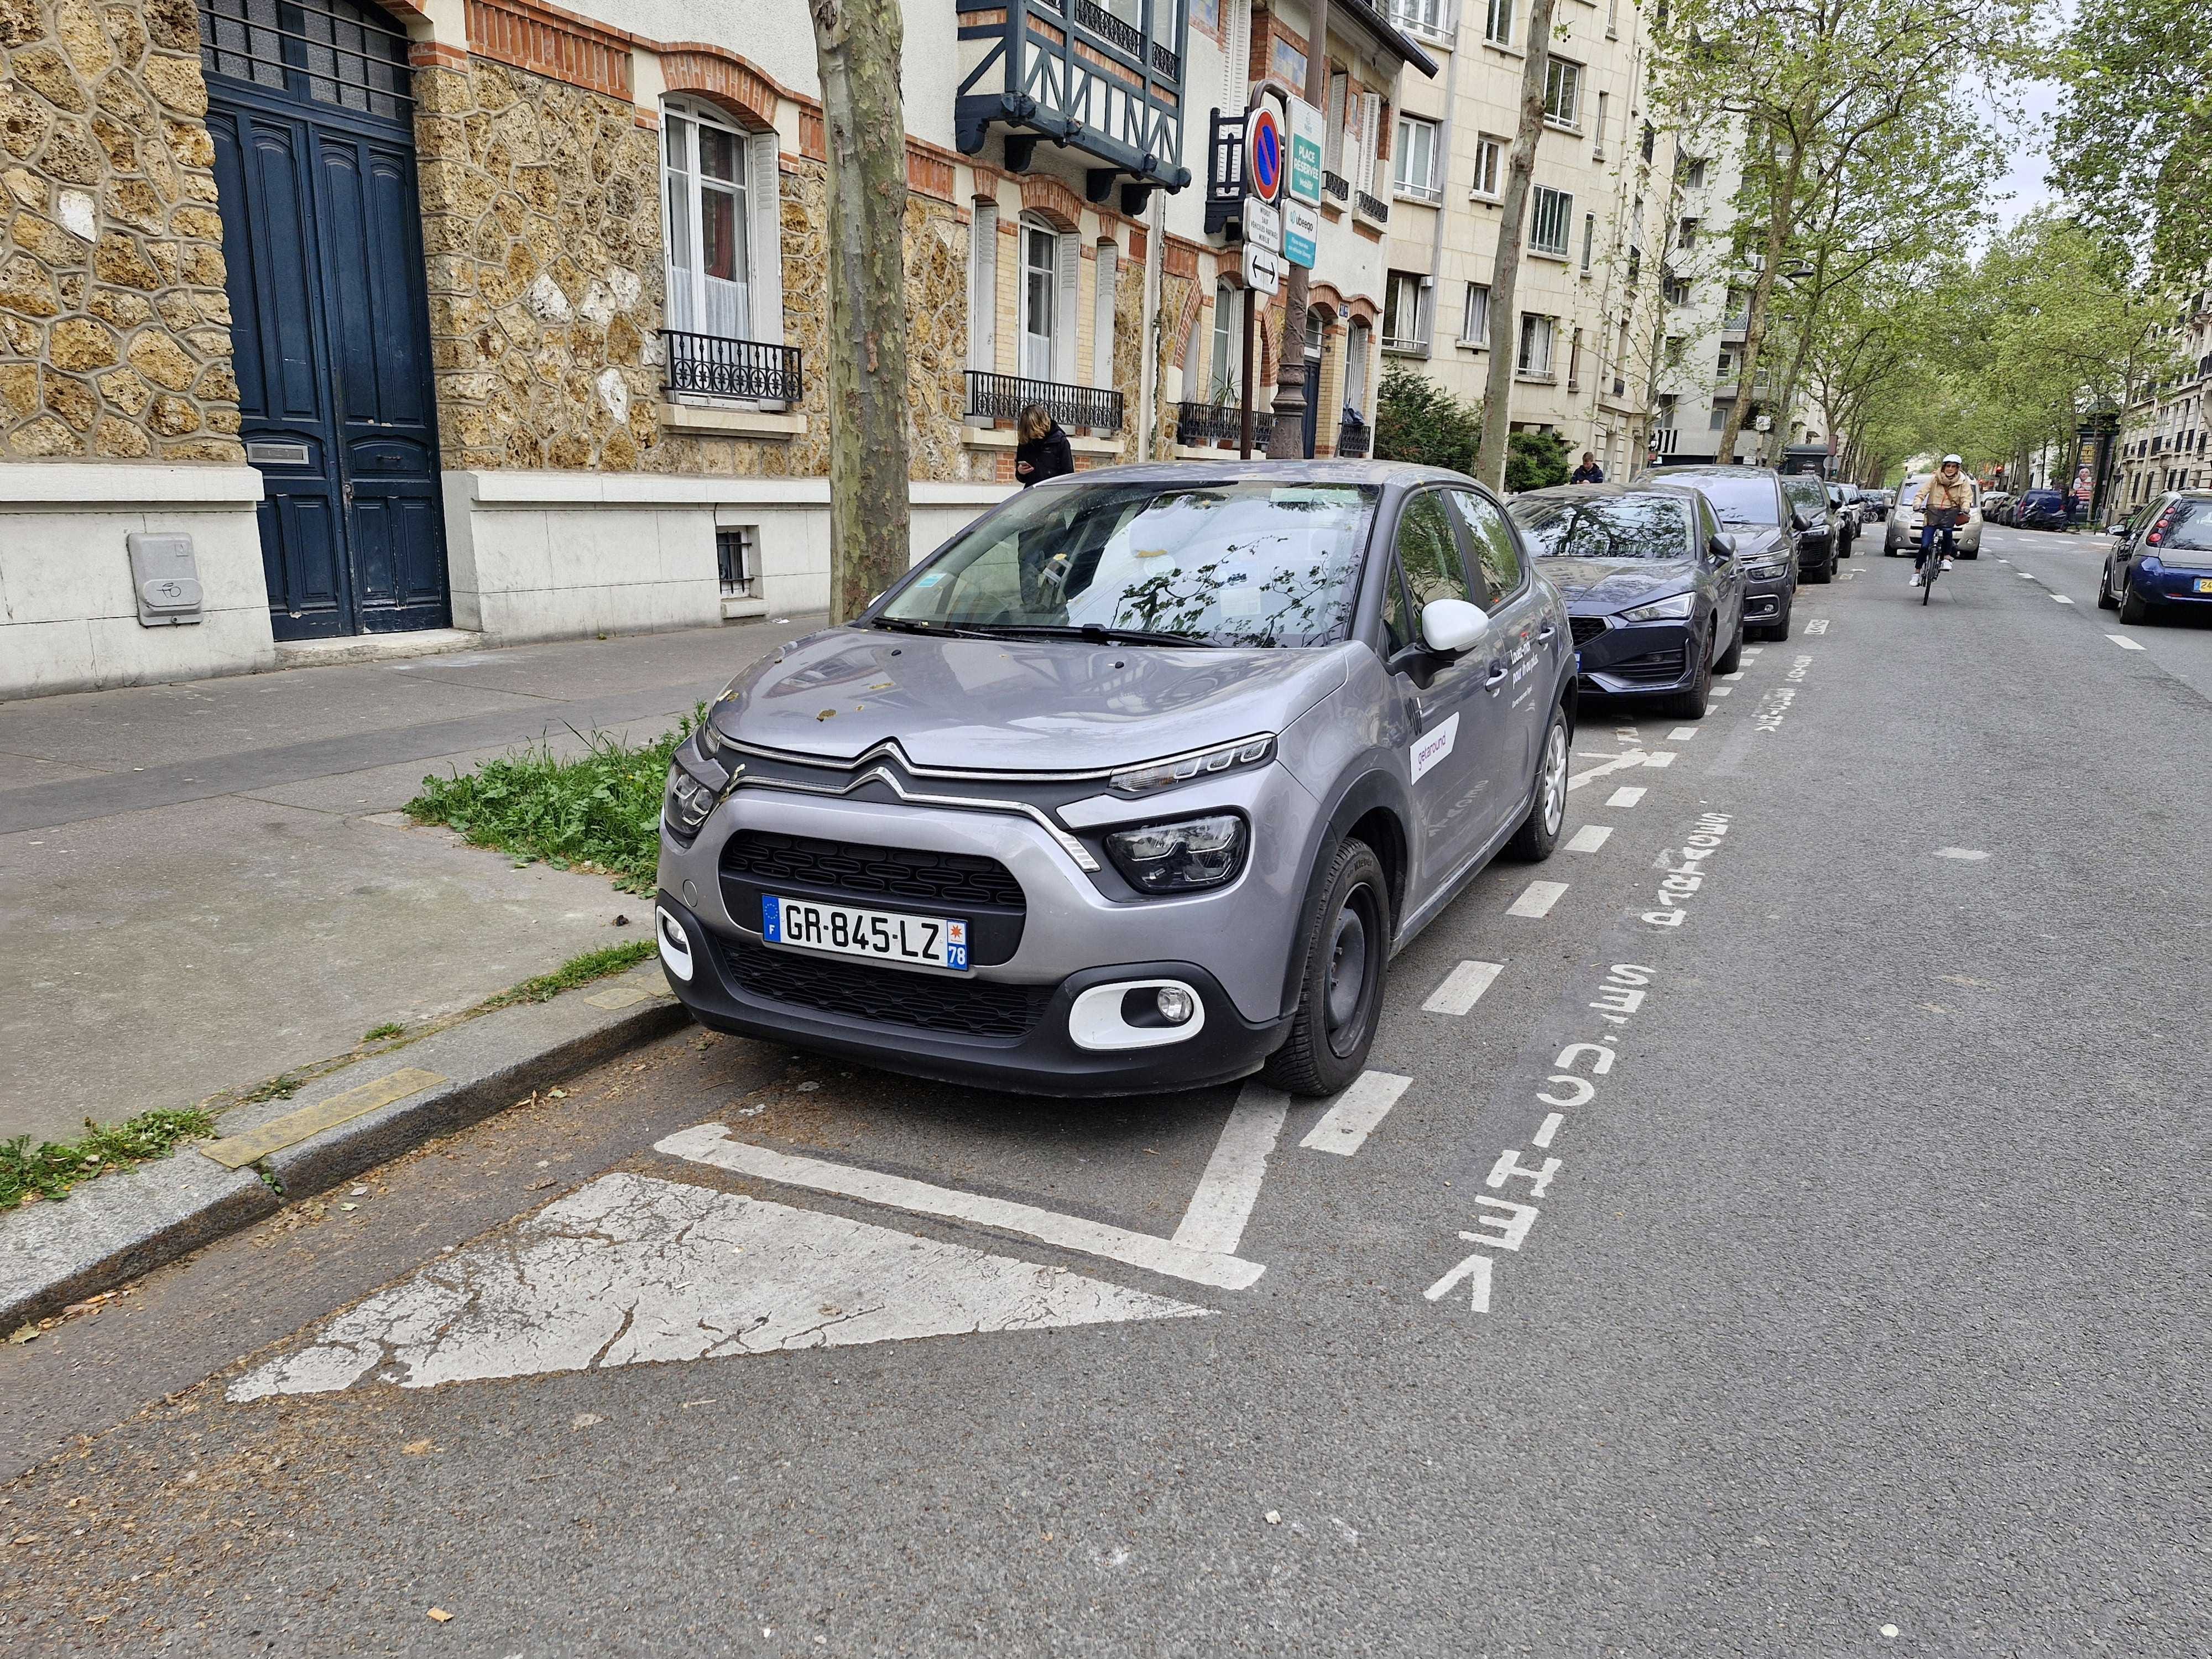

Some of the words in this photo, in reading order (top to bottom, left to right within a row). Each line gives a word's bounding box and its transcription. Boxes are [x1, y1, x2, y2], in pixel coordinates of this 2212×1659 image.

[1298, 145, 1315, 163] PLACE
[1293, 157, 1319, 180] RÉSERVÉE
[1296, 213, 1313, 233] ubeeqo
[1418, 730, 1446, 771] getaround
[769, 924, 775, 935] F
[785, 904, 940, 960] GR-845-LZ
[948, 946, 966, 965] 78
